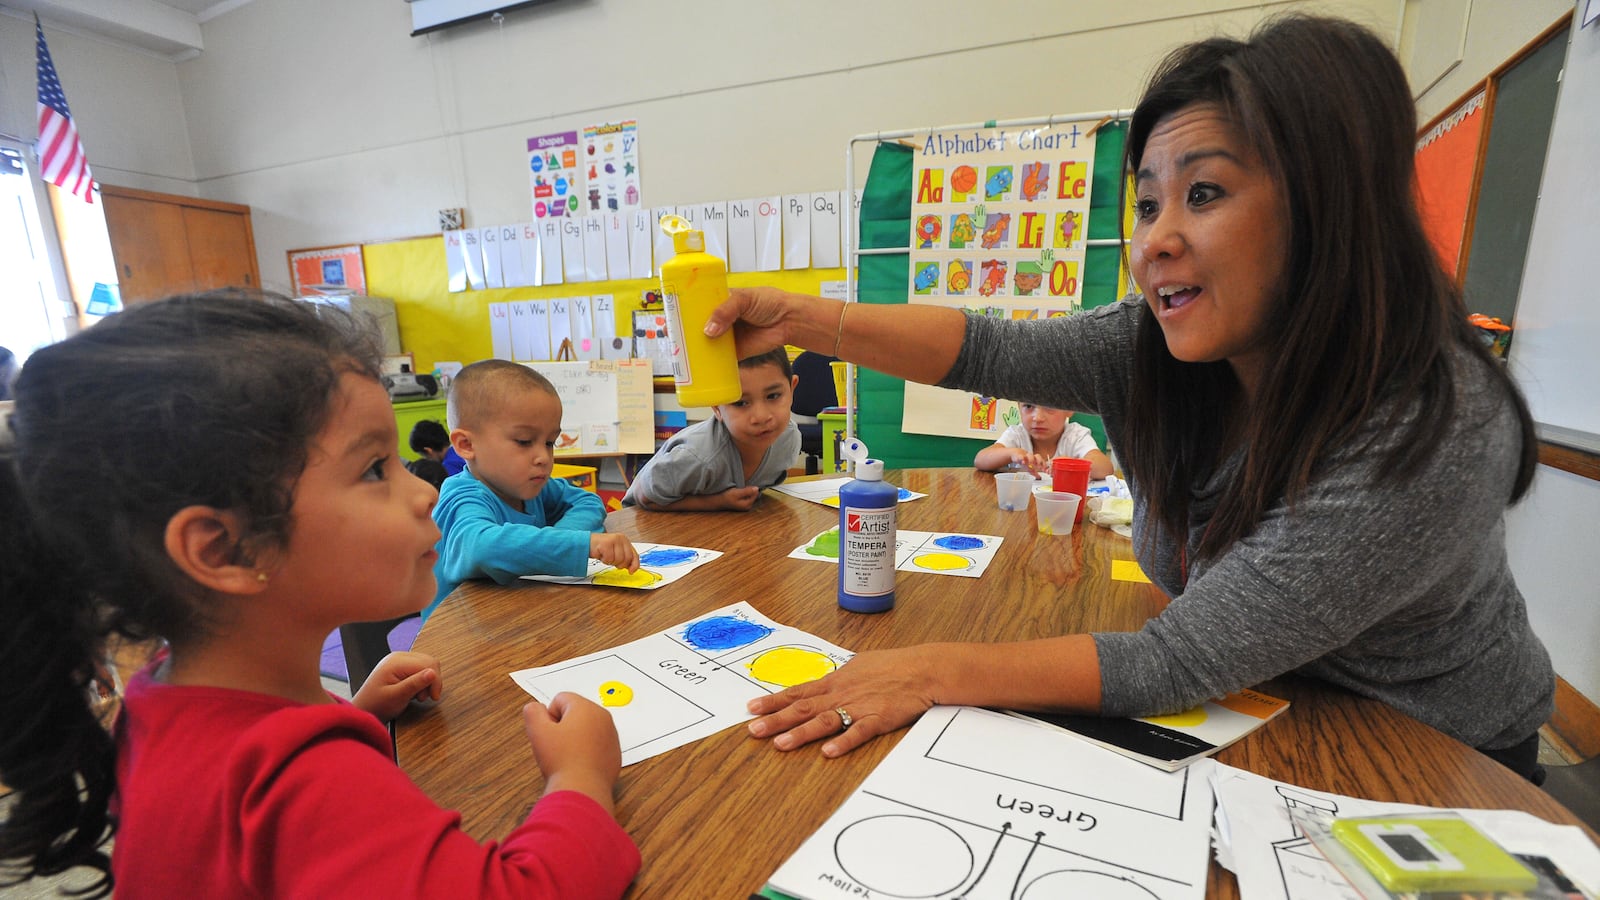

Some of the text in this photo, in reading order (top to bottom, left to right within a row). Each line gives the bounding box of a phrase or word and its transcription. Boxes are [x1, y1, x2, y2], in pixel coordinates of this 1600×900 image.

[538, 137, 564, 147] Shapes
[922, 125, 1081, 157] Alphabet Chart
[916, 168, 944, 204] Aa
[1056, 160, 1086, 199] Ee
[503, 228, 516, 240] Dd
[524, 227, 535, 240] Ee
[564, 222, 580, 237] Gg
[586, 221, 600, 232] Hh
[704, 206, 724, 220] Mm
[733, 204, 749, 218] Nn
[758, 202, 776, 216] Oo
[790, 199, 803, 216] Pp
[814, 197, 836, 214] Qq
[1018, 212, 1042, 248] Ii
[1049, 260, 1077, 296] Oo
[530, 303, 546, 316] Ww
[554, 302, 565, 314] Xx
[575, 300, 586, 316] Yy
[598, 298, 610, 312] Zz
[860, 521, 890, 532] Artist
[848, 540, 886, 549] TEMPERA
[658, 660, 707, 685] Green
[996, 794, 1097, 831] Green
[818, 874, 870, 899] Yellow
